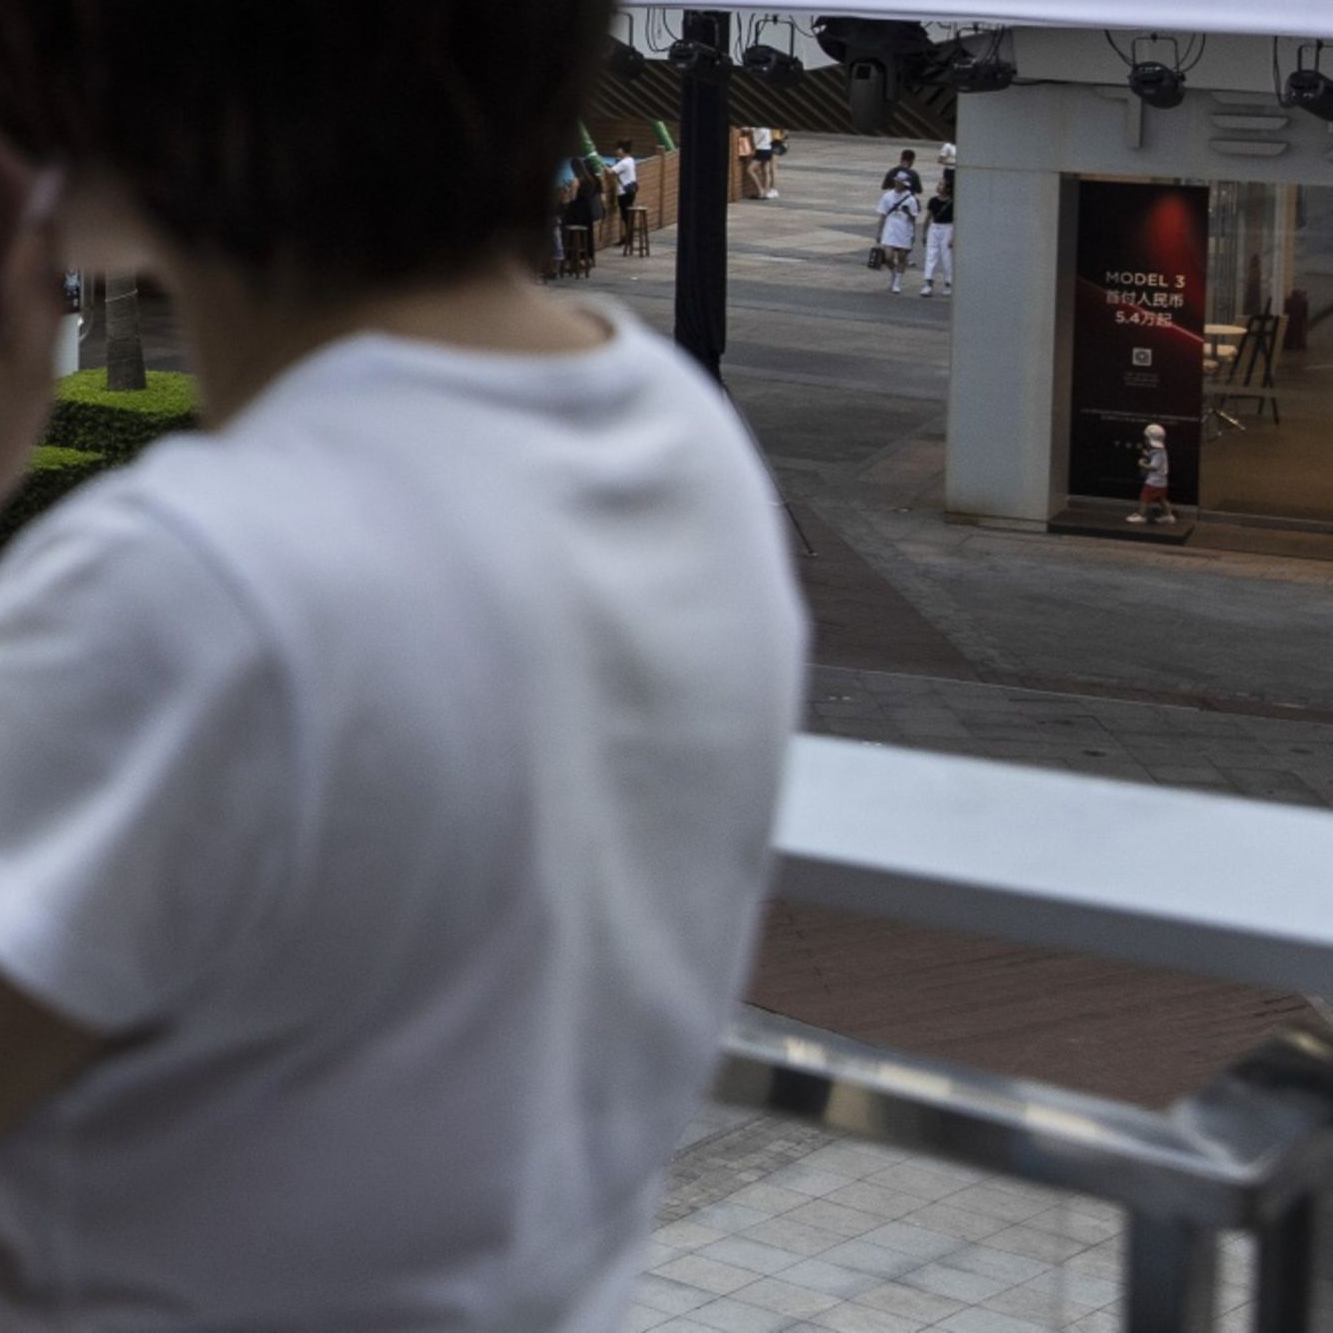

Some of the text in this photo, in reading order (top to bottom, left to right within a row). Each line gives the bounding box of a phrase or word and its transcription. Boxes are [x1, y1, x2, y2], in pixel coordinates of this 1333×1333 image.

[1105, 270, 1186, 289] MODEL 3
[1105, 289, 1184, 308] 首付人民币
